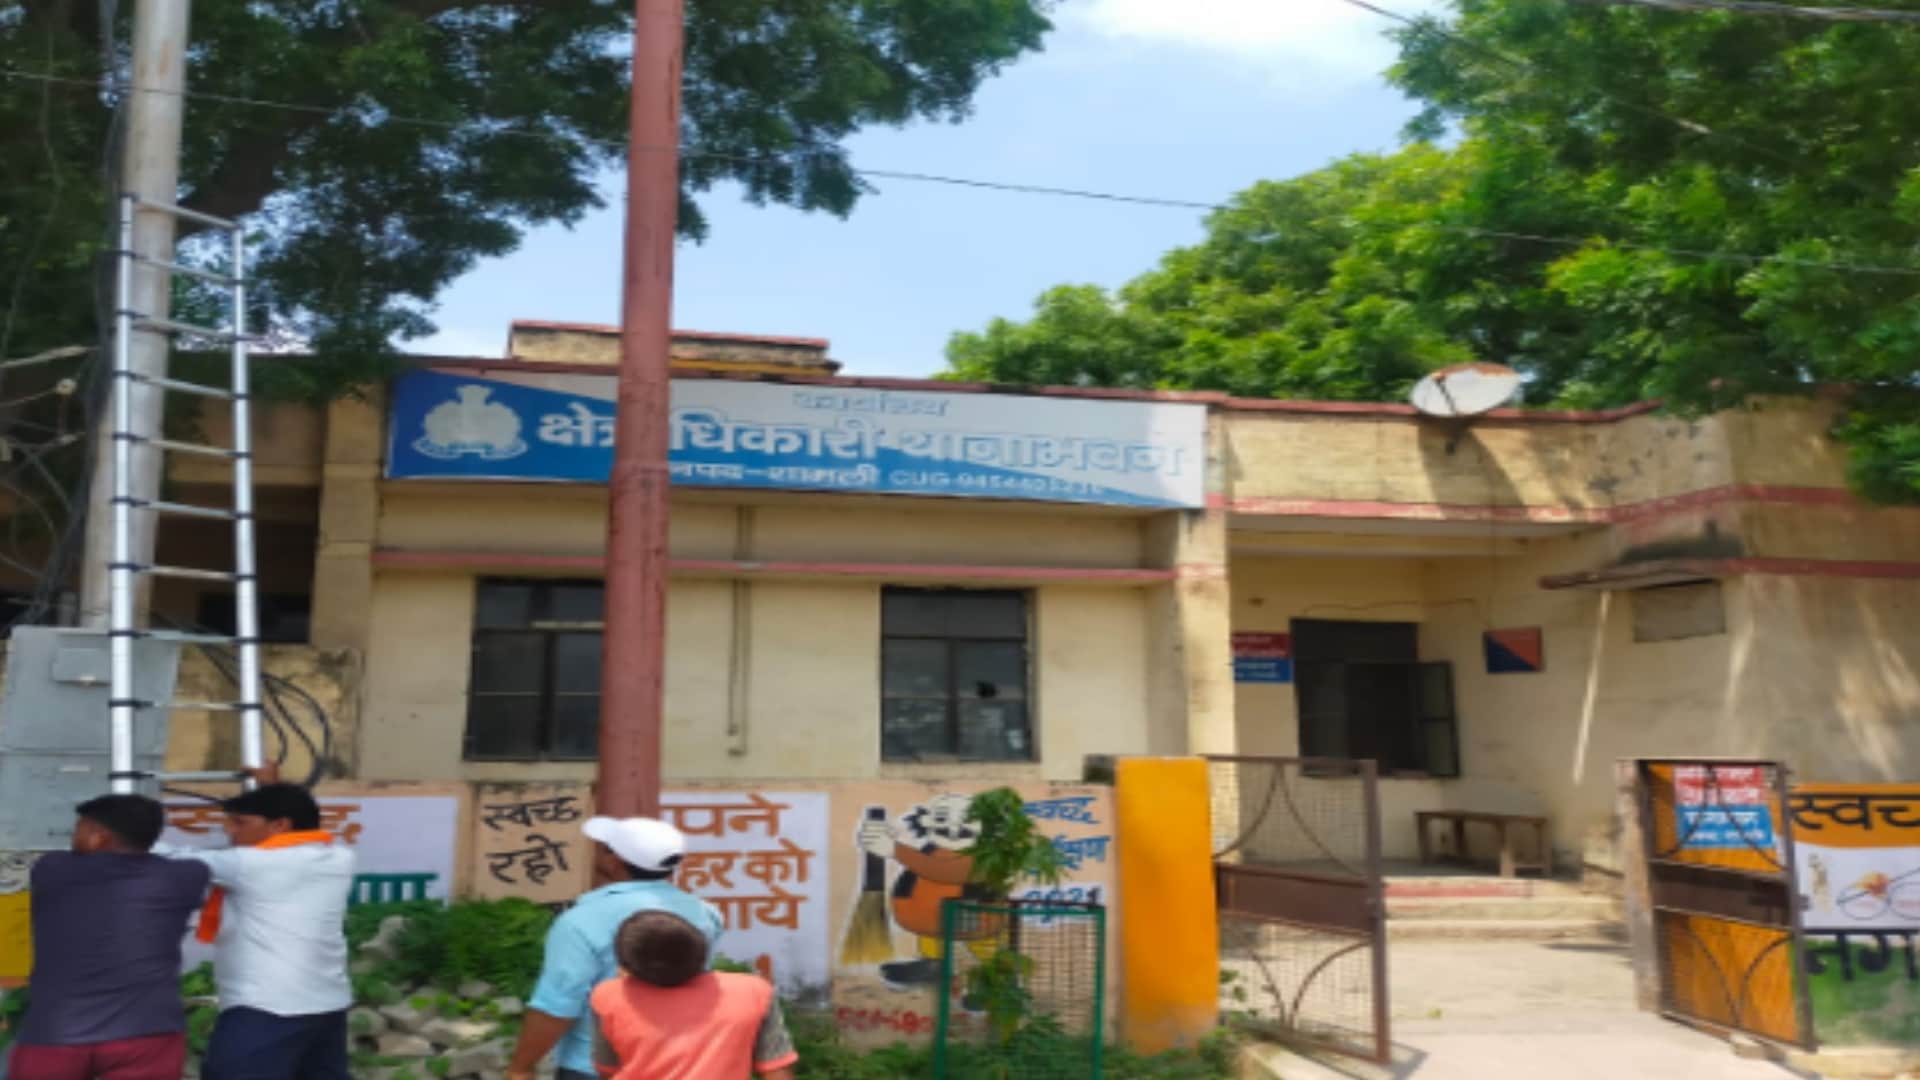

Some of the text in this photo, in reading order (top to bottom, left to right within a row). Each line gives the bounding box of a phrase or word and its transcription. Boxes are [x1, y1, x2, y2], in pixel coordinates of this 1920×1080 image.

[660, 791, 793, 838] पने
[484, 832, 569, 886] रहो
[676, 850, 743, 893] हर
